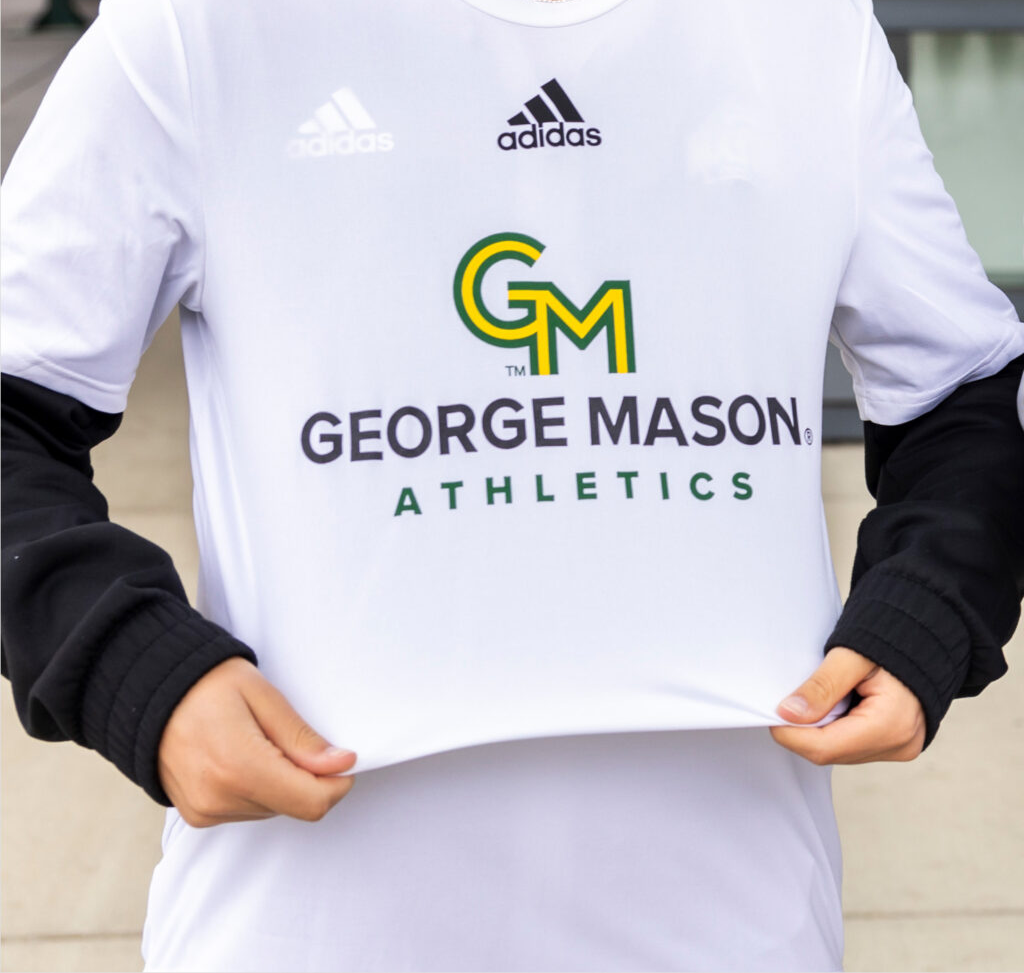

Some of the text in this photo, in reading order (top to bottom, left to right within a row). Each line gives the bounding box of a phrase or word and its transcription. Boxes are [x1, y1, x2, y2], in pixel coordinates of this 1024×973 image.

[497, 121, 603, 151] adidas
[452, 231, 637, 377] GM
[300, 396, 568, 465] GEORGE
[393, 470, 754, 517] ATHLETICS
